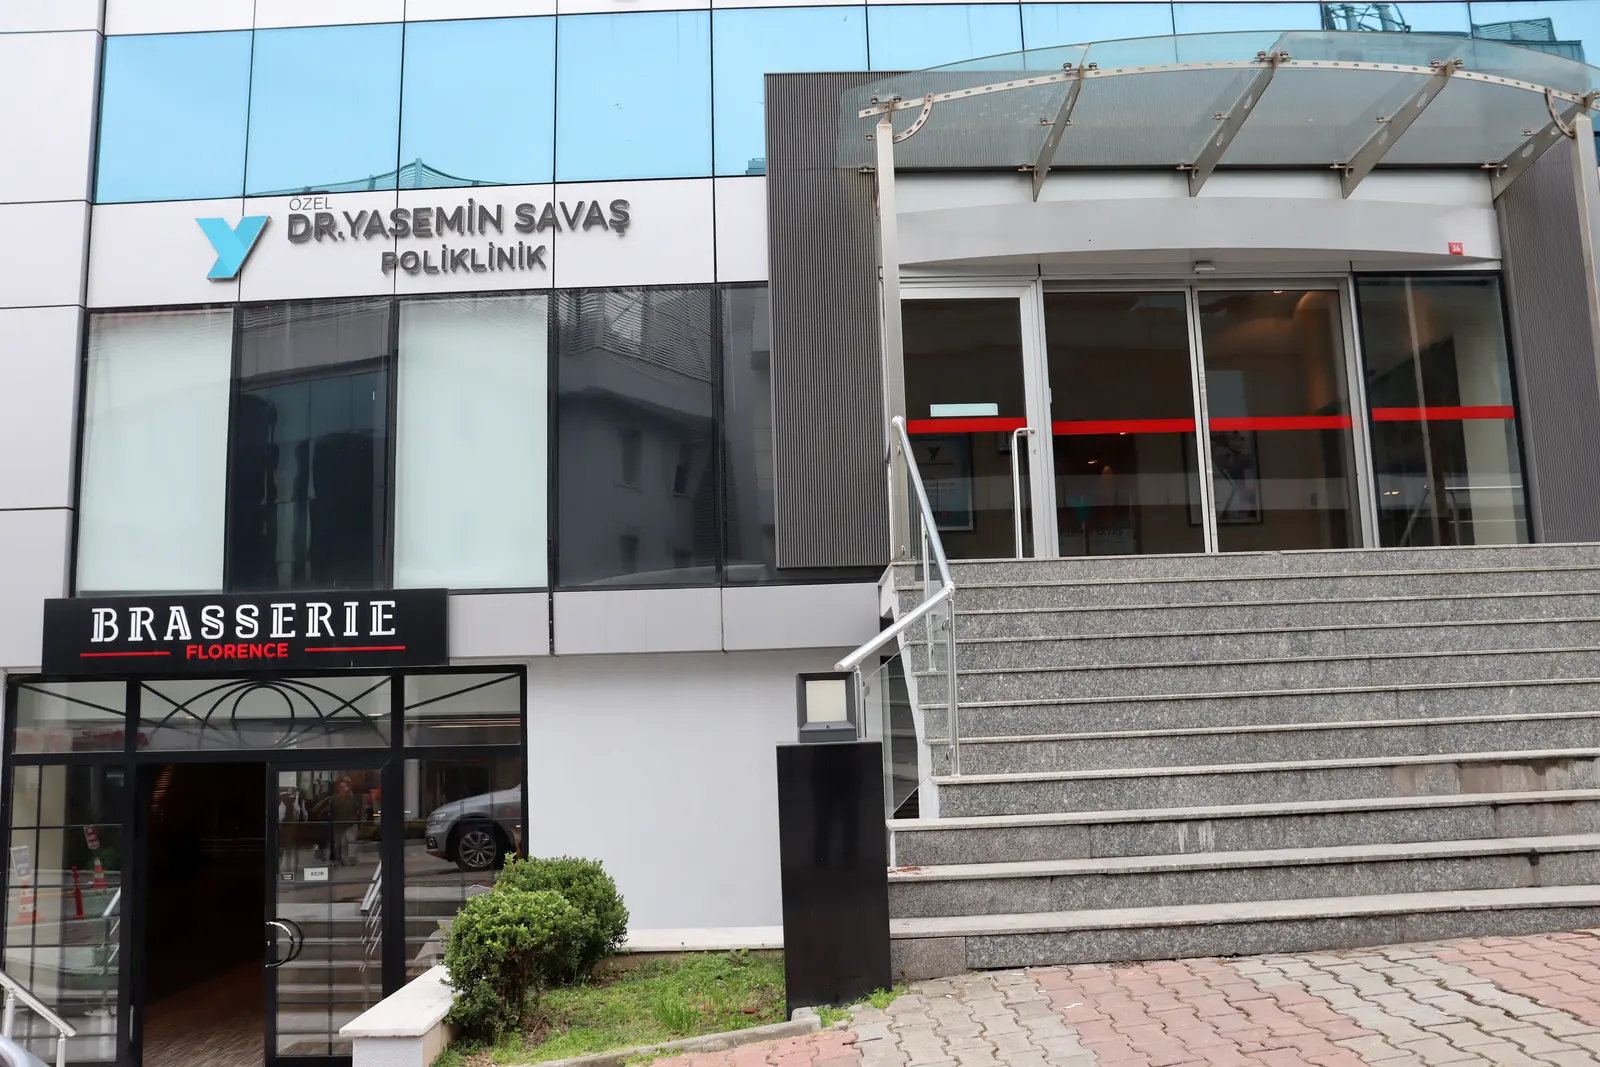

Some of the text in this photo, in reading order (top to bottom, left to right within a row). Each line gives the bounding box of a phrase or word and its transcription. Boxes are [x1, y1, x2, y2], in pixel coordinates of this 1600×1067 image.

[289, 196, 333, 211] ÖZEL
[514, 199, 631, 237] SAVAŞ
[381, 241, 547, 275] POLİKLİNİK
[91, 600, 396, 643] BRASSERIE
[186, 643, 289, 660] FLORENCE
